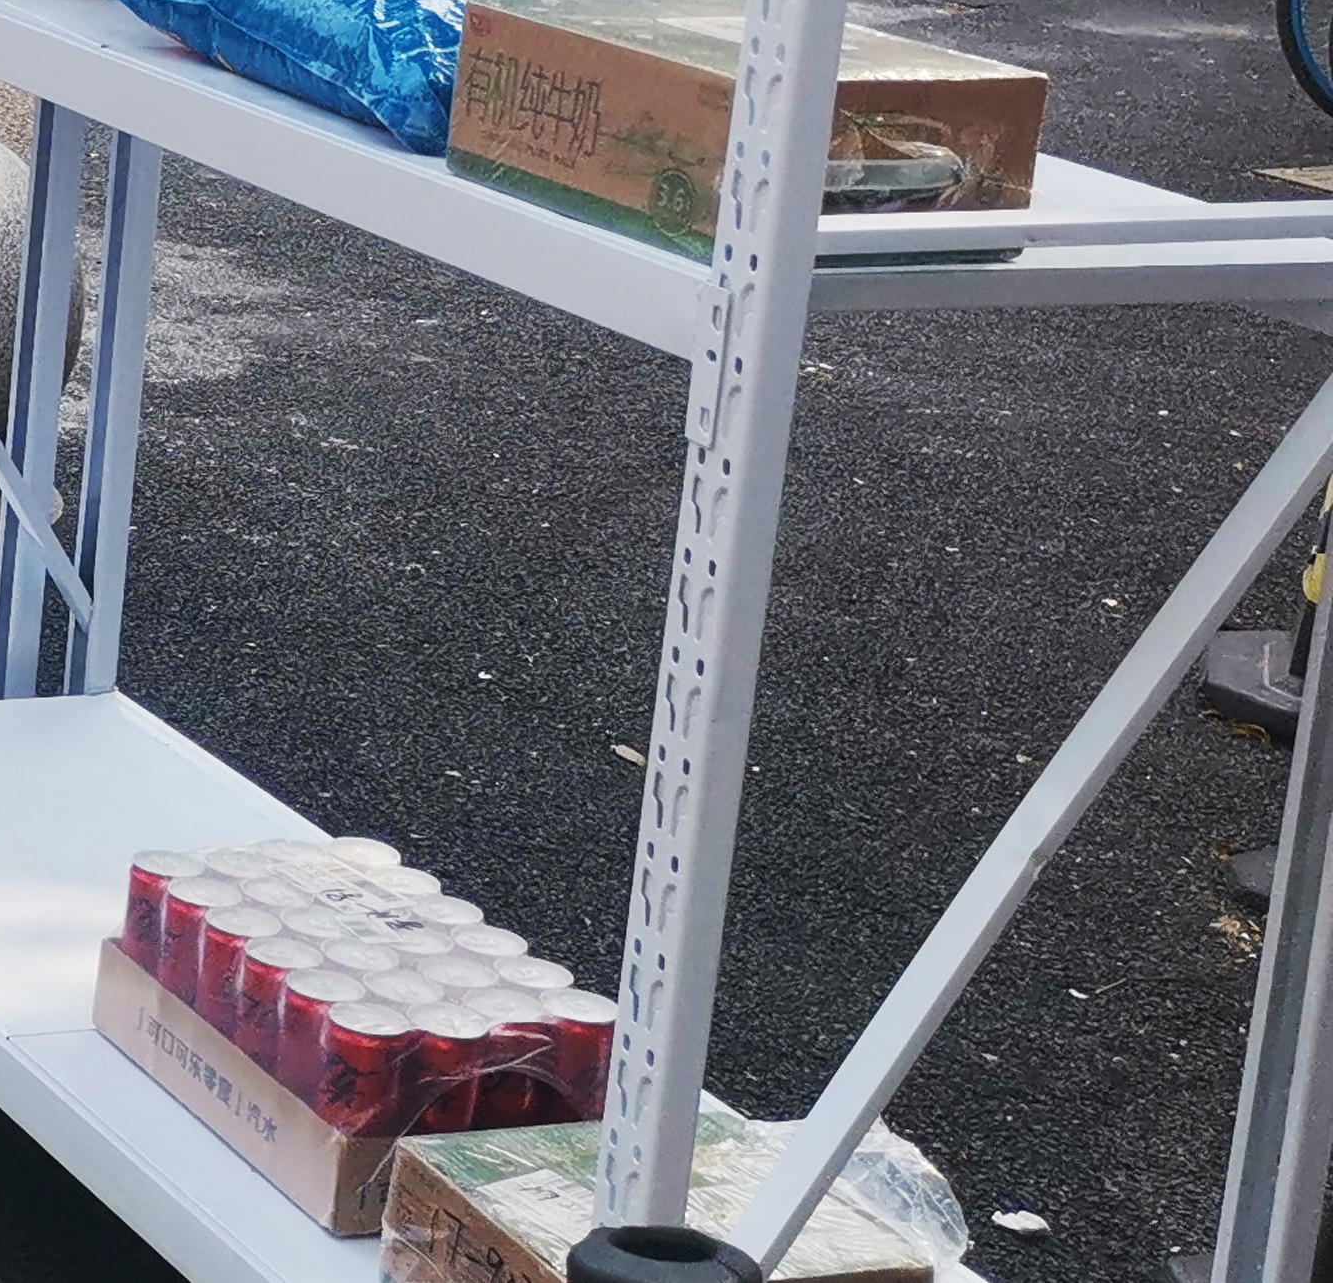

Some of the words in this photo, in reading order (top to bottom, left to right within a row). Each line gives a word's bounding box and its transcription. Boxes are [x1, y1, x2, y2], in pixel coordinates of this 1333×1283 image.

[464, 46, 601, 158] 有机纯牛奶
